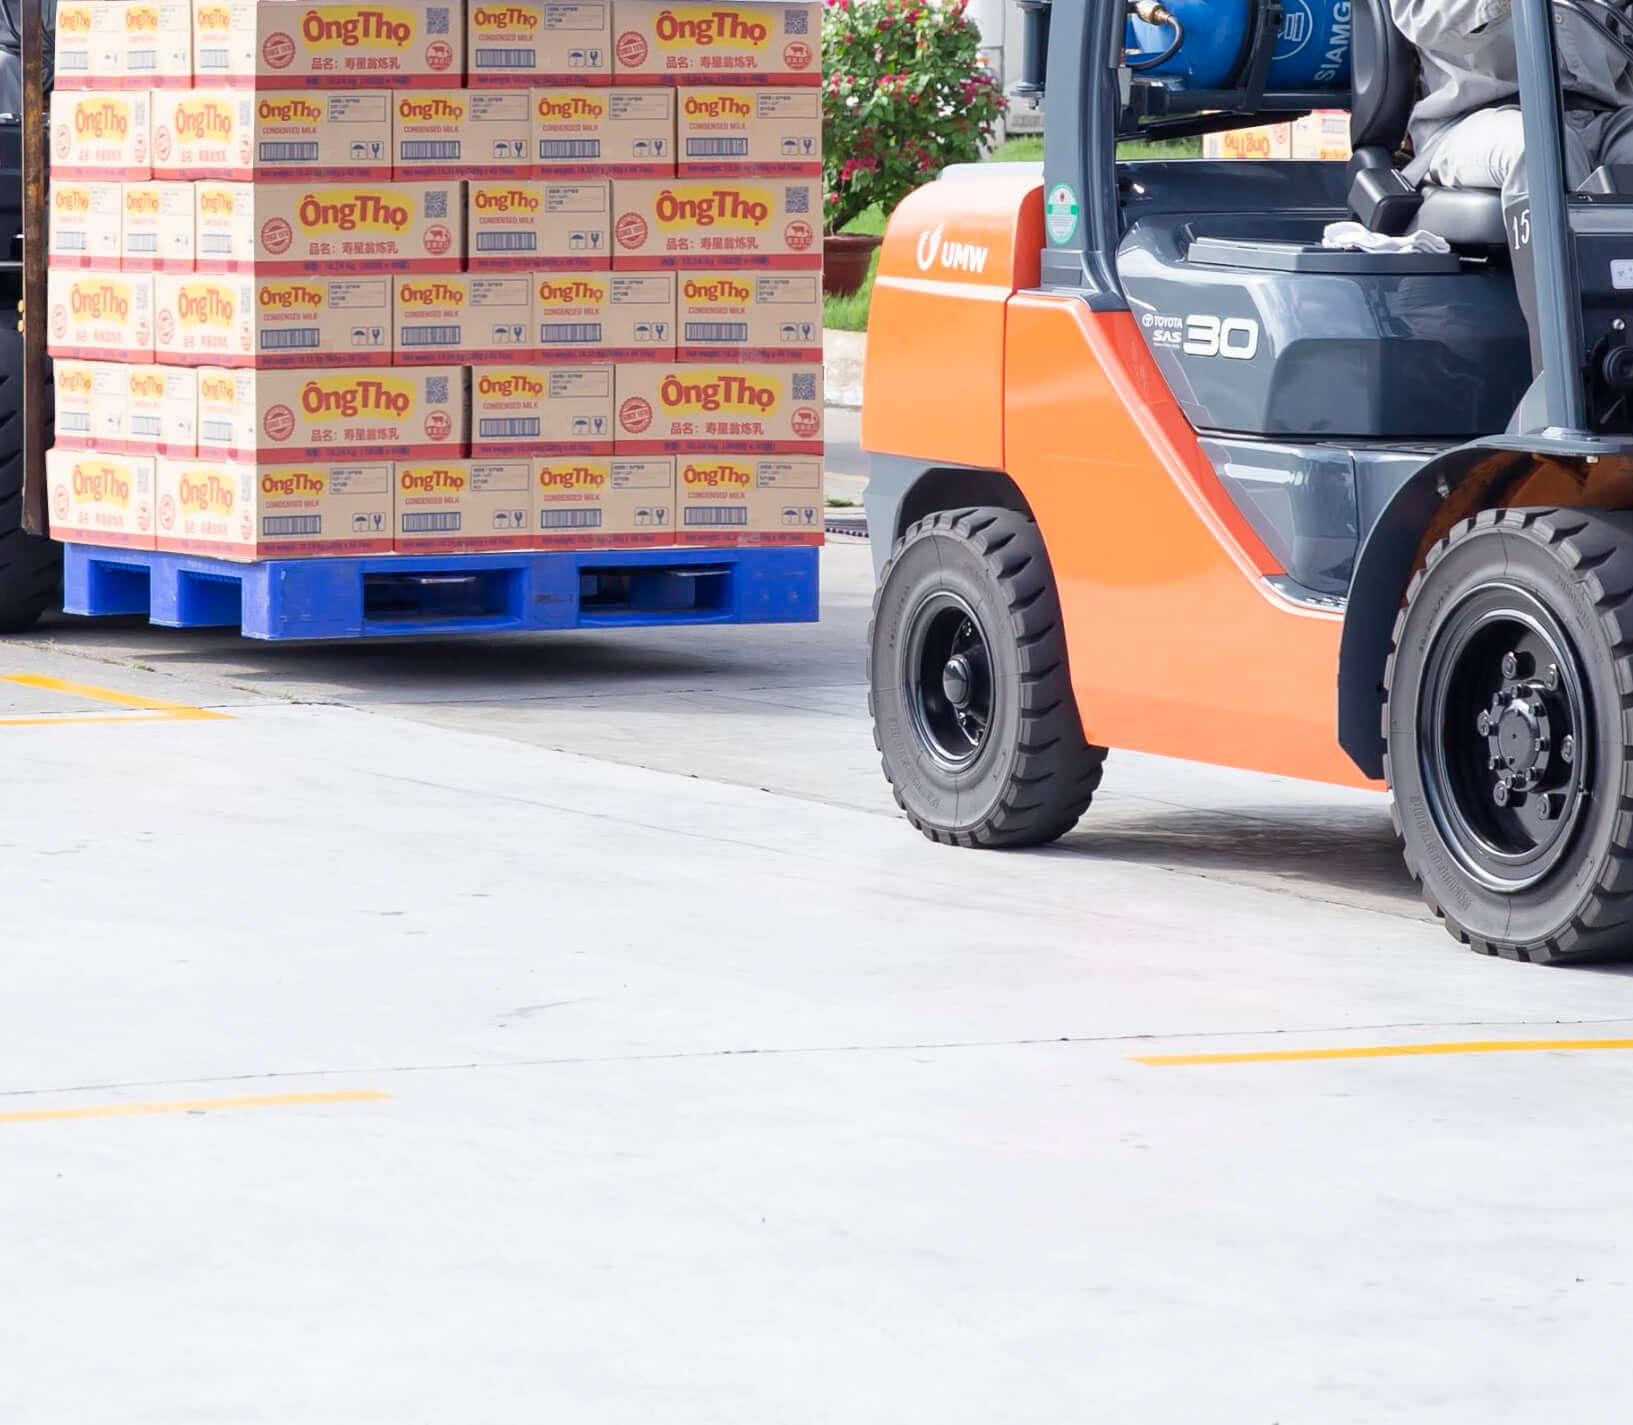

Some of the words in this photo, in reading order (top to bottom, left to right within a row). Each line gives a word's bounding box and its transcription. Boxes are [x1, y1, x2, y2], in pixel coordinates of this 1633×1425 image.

[1513, 209, 1530, 250] 15
[941, 241, 989, 273] UMW
[1152, 330, 1182, 343] SAS
[1154, 315, 1183, 328] TOYOTA
[1183, 314, 1258, 359] 30
